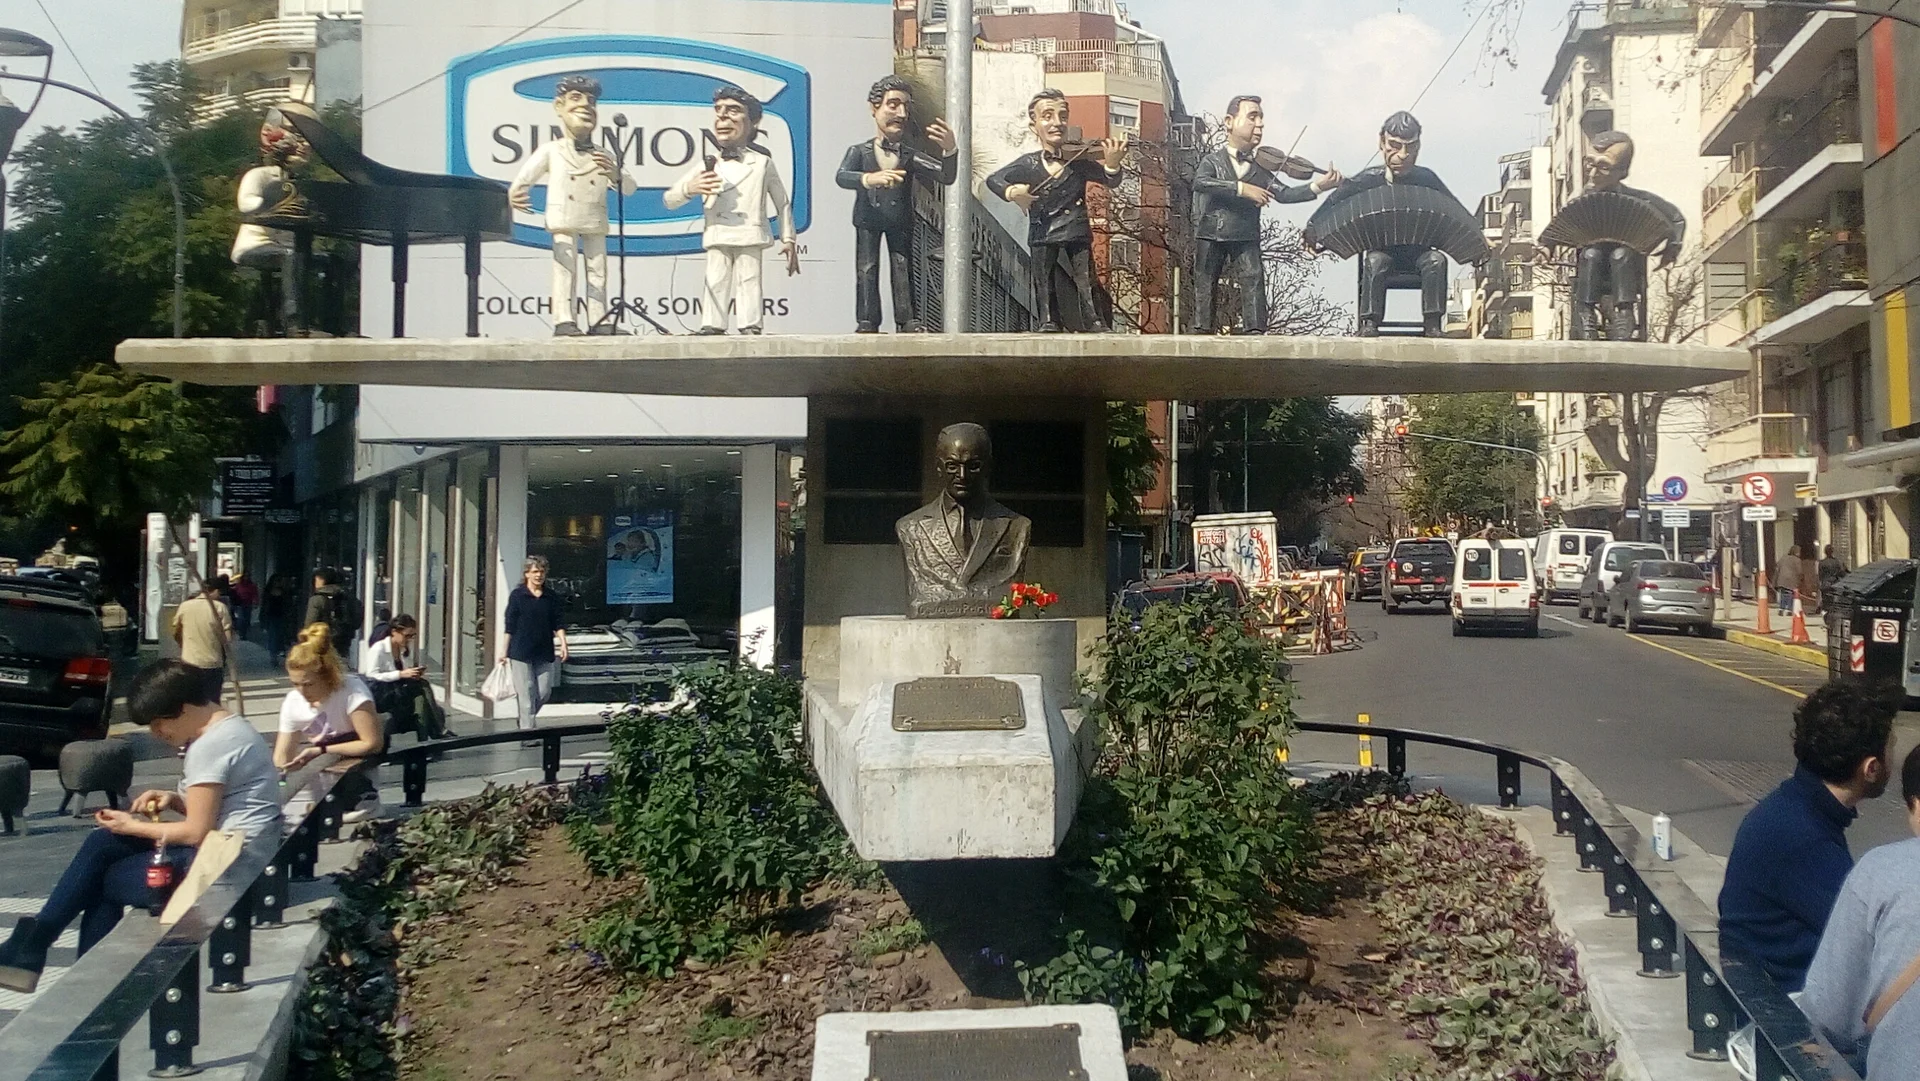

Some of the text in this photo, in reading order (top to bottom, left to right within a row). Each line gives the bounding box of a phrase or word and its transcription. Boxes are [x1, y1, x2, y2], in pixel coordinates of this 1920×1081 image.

[477, 296, 789, 316] COLCHNS & SOMRS
